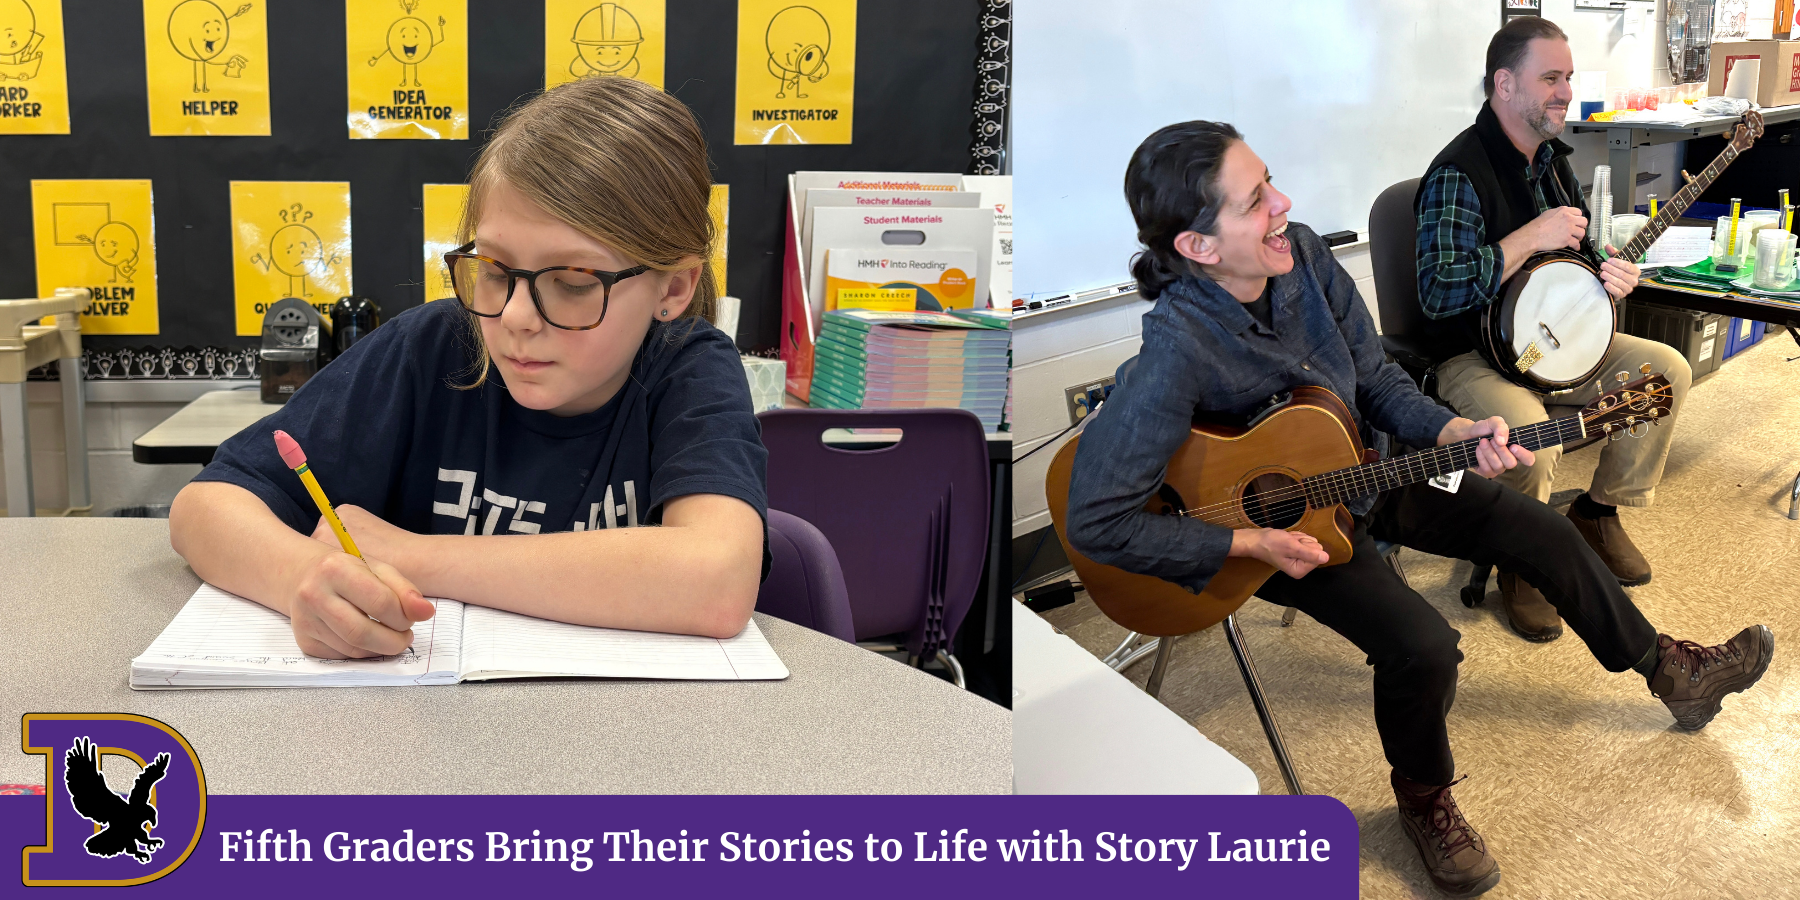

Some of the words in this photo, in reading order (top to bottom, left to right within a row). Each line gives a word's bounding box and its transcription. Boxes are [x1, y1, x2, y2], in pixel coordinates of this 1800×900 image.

[394, 90, 426, 105] IDEA
[0, 103, 42, 117] RKER
[182, 100, 238, 116] HELPER
[368, 106, 452, 120] GENERATOR
[752, 109, 838, 121] INVESTIGATOR
[856, 196, 890, 206] Teacher
[892, 197, 932, 206] Materials
[864, 216, 899, 225] Student
[901, 215, 943, 224] Materials
[857, 259, 880, 268] HMH
[889, 259, 907, 269] Into
[908, 259, 947, 271] Reading
[82, 302, 130, 316] OLVER
